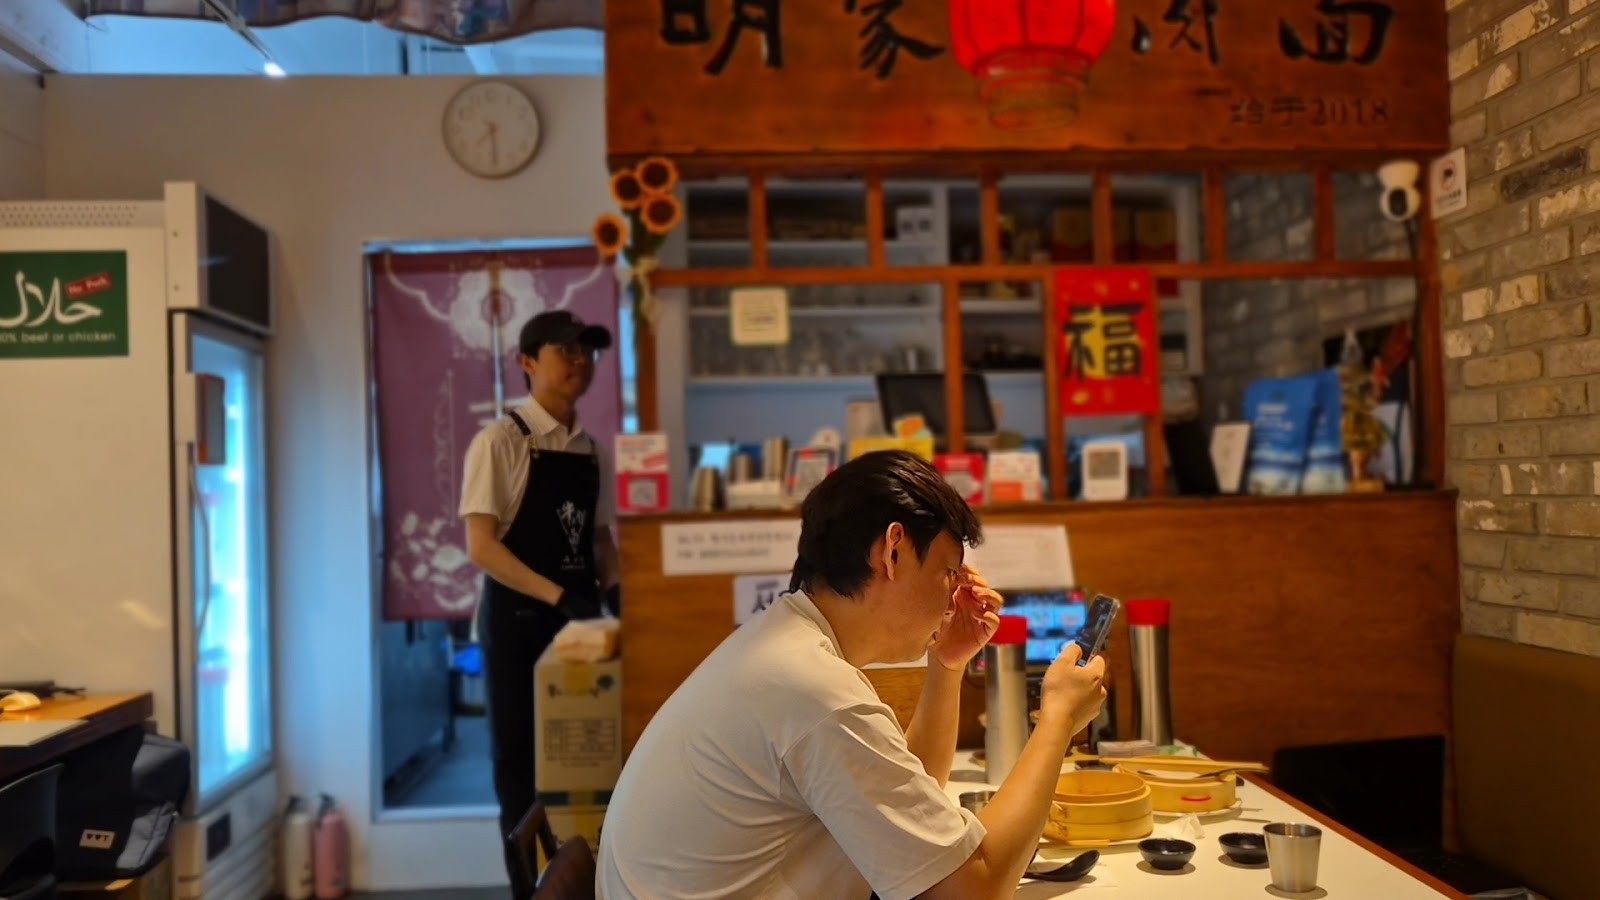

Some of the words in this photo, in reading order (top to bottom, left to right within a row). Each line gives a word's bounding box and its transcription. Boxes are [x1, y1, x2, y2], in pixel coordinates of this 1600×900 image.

[21, 332, 49, 343] beef
[52, 333, 65, 343] or
[68, 332, 117, 343] chicken
[1062, 301, 1144, 381] 福
